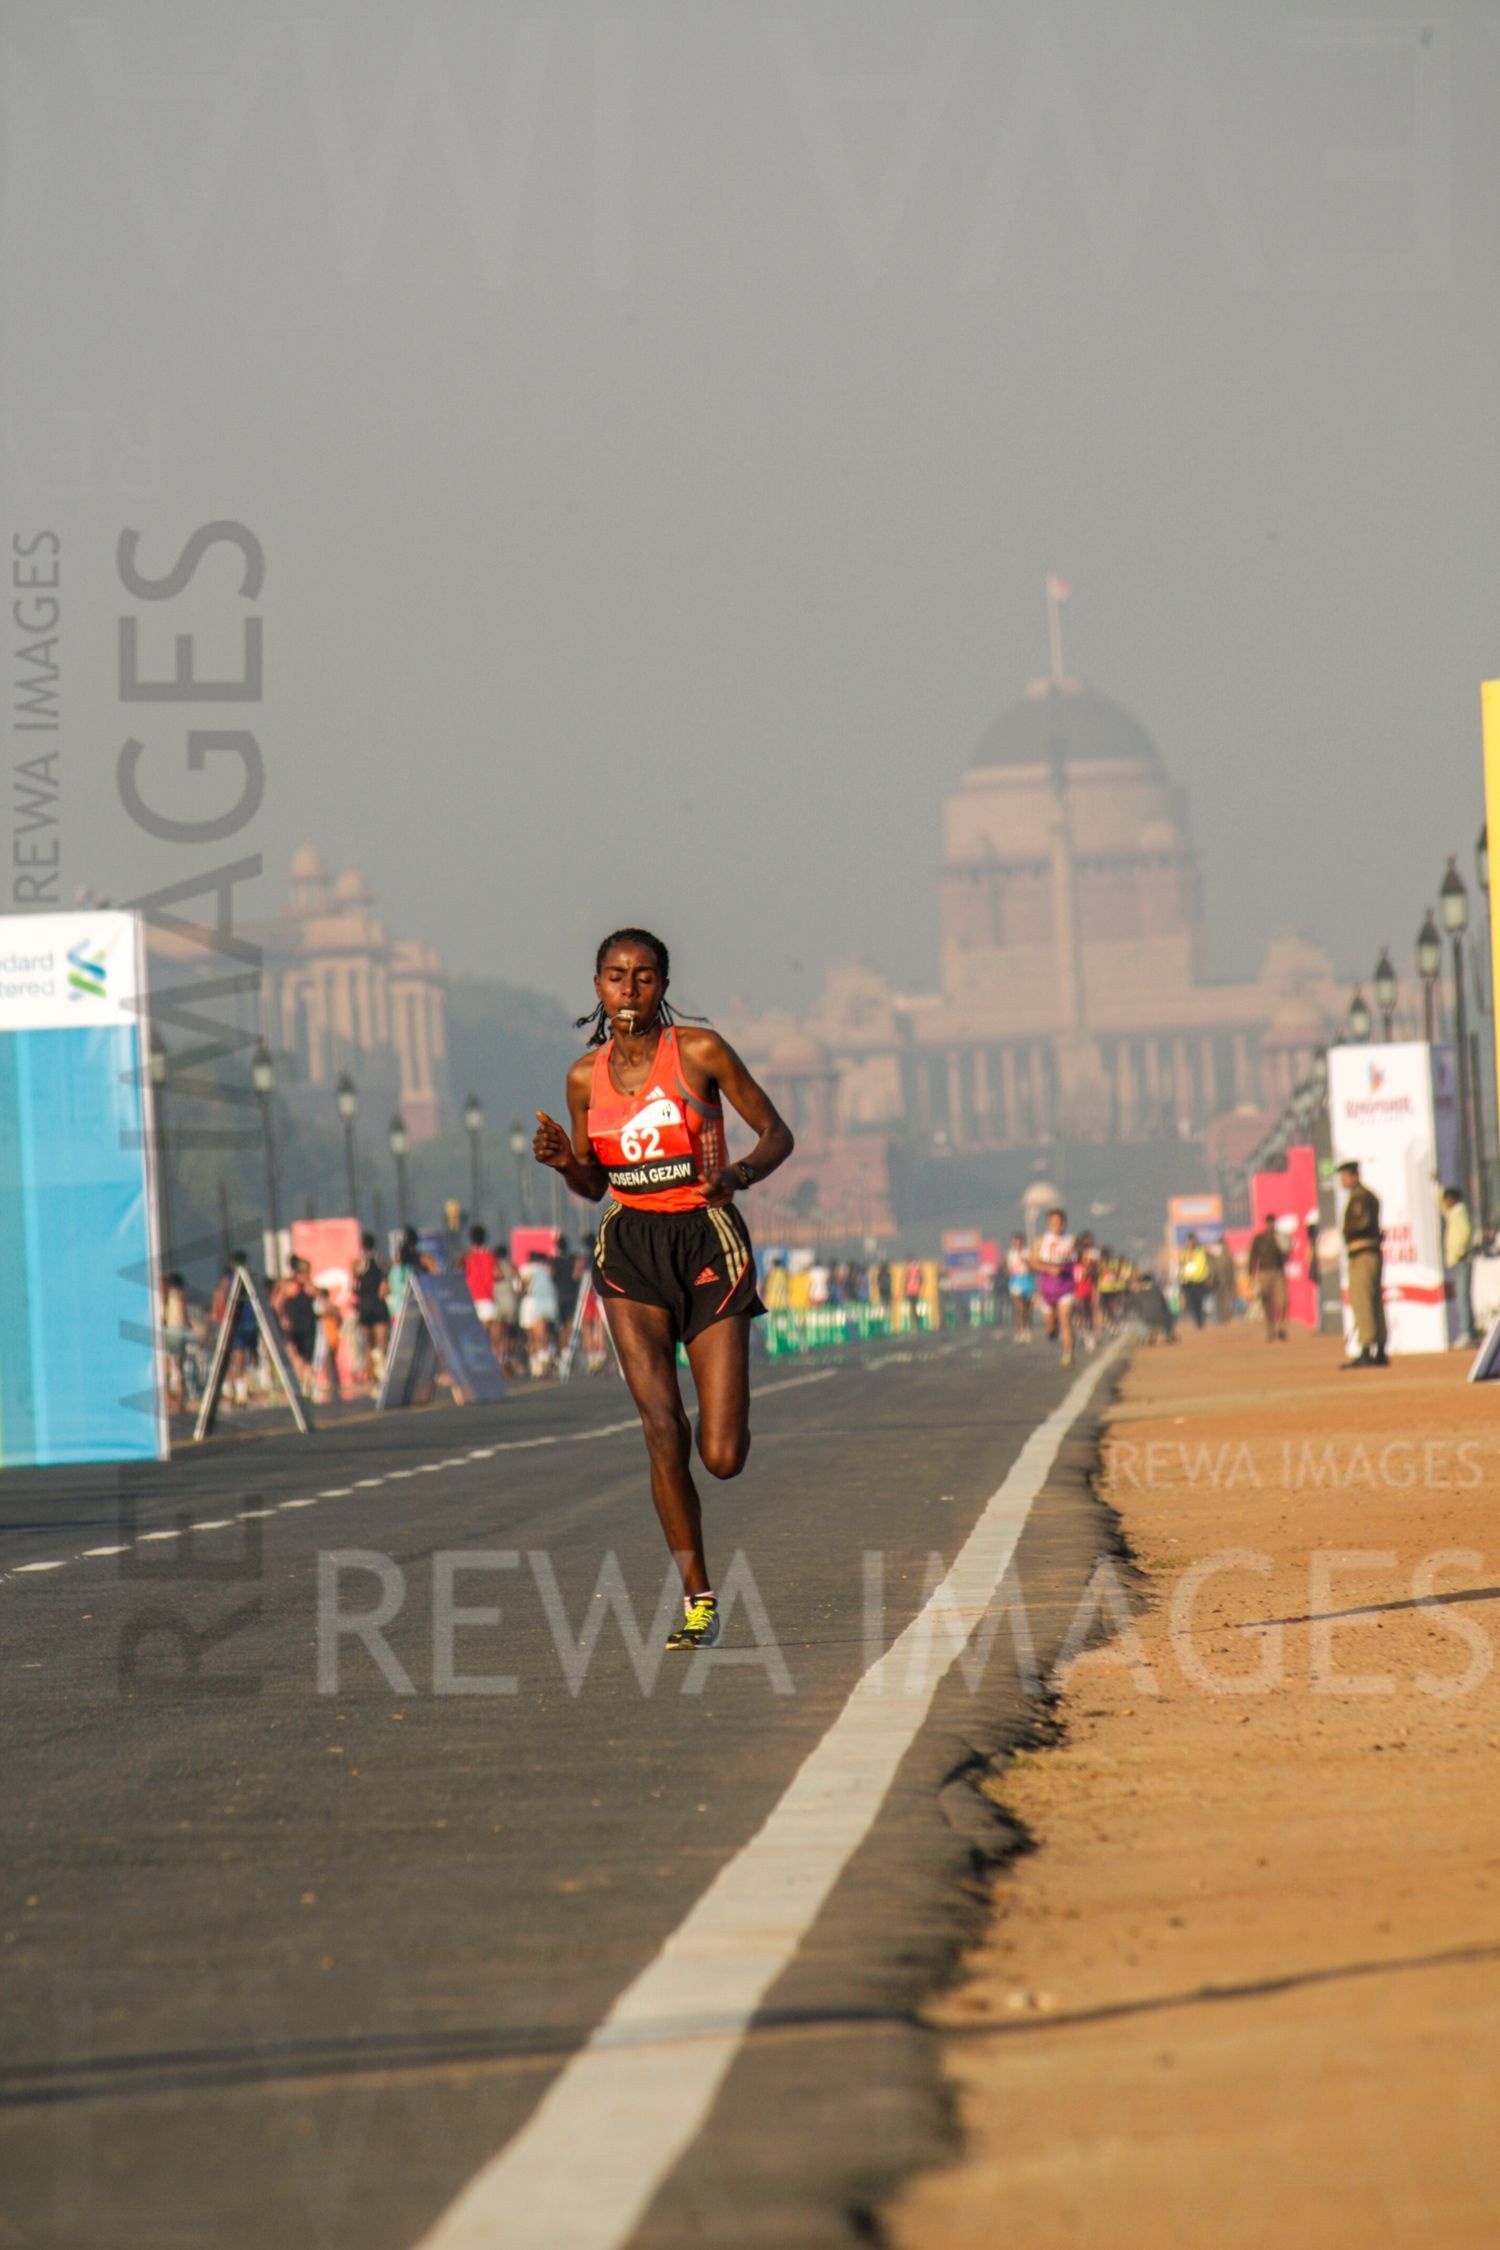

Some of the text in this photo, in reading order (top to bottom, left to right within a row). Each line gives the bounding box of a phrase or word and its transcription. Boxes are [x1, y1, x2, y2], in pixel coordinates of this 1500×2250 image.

[0, 952, 54, 973] dard
[620, 1127, 665, 1162] 62
[649, 1162, 691, 1182] GEZAW
